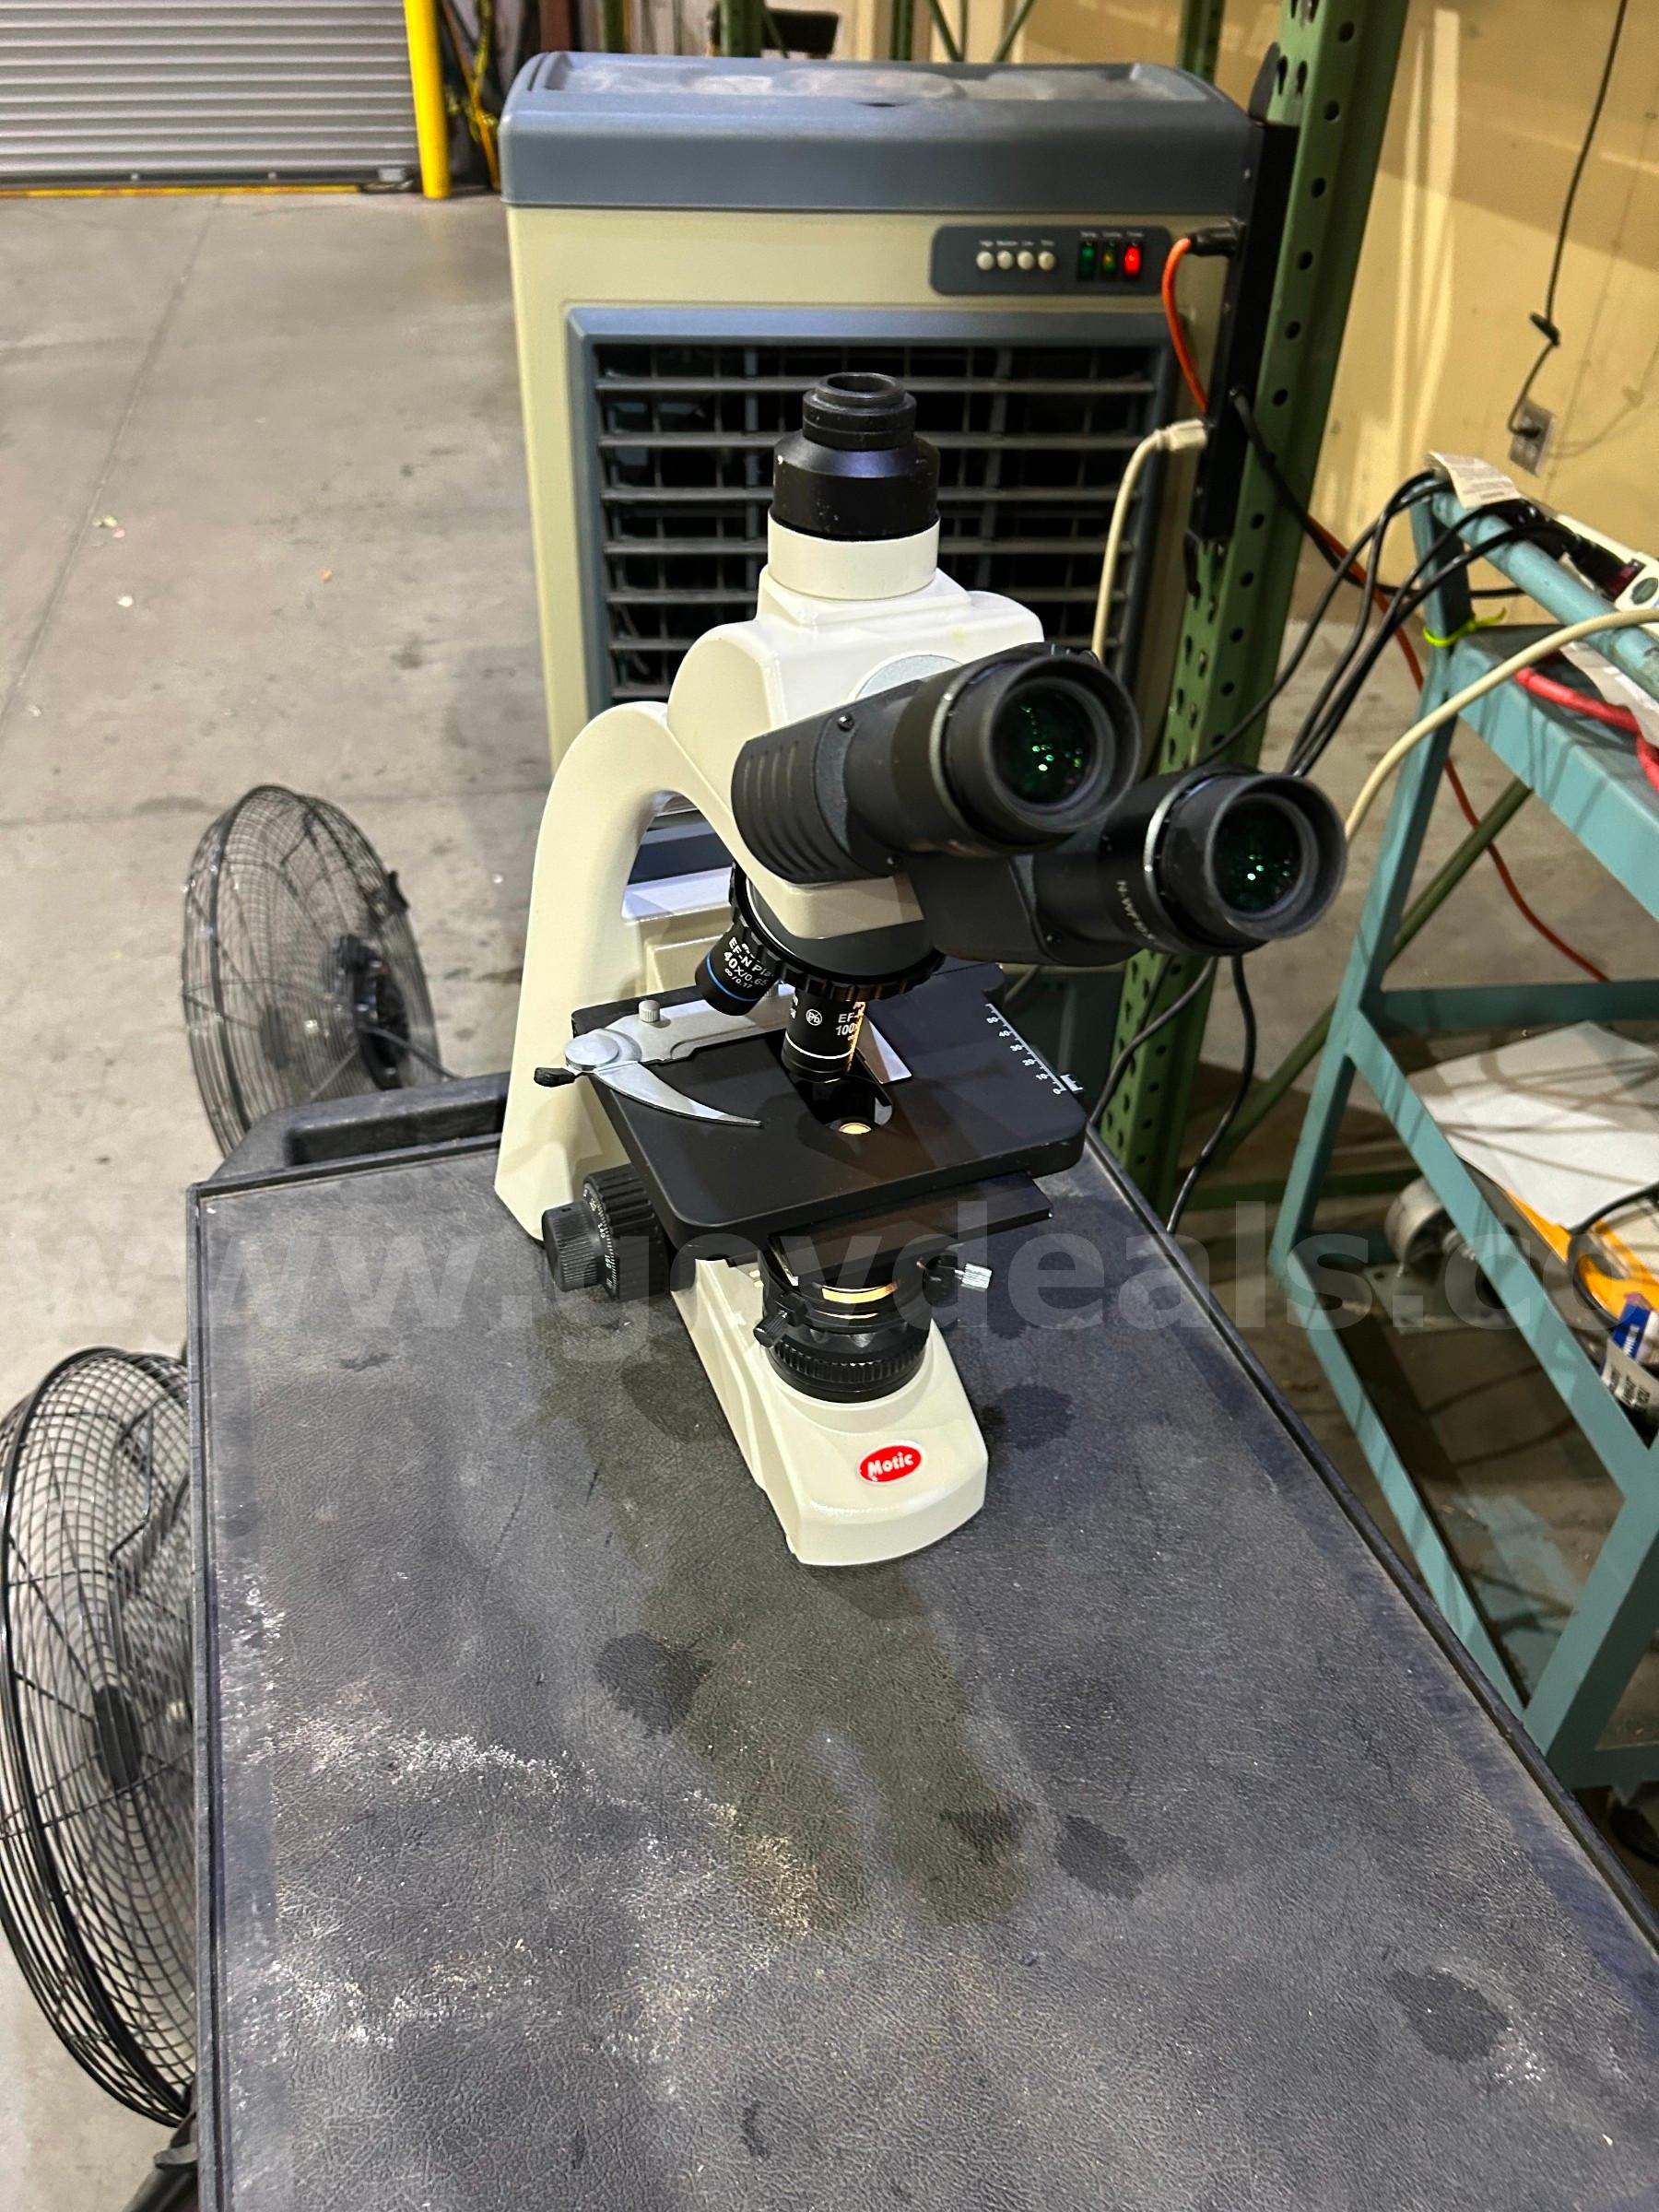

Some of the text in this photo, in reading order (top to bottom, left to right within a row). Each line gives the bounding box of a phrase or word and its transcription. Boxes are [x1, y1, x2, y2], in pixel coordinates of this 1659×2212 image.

[728, 936, 753, 968] EF-N
[751, 964, 773, 978] Pla
[724, 951, 769, 986] 40X/0.65
[838, 1012, 860, 1023] EF-
[835, 1022, 857, 1036] 100
[1022, 1058, 1035, 1066] 20
[867, 1452, 914, 1477] Motic
